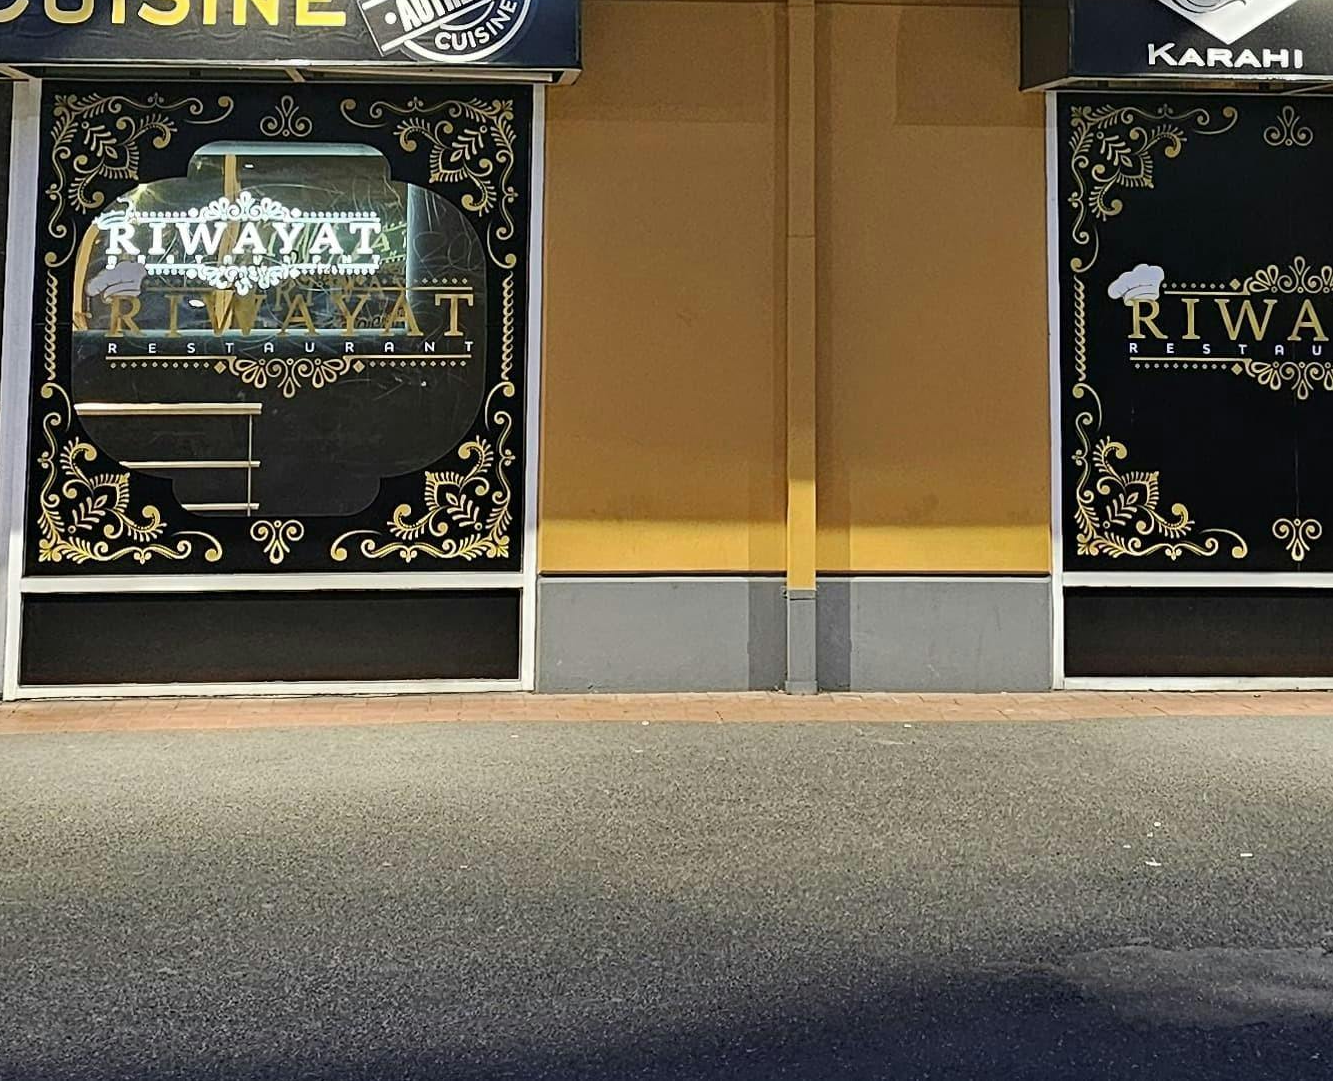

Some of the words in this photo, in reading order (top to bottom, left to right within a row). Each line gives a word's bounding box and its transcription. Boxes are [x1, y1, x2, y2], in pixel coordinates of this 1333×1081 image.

[1148, 42, 1304, 70] KARAHI
[105, 222, 382, 256] RIWAYAT
[104, 293, 474, 338] RIWAYAT
[108, 341, 474, 354] RESTAURANT
